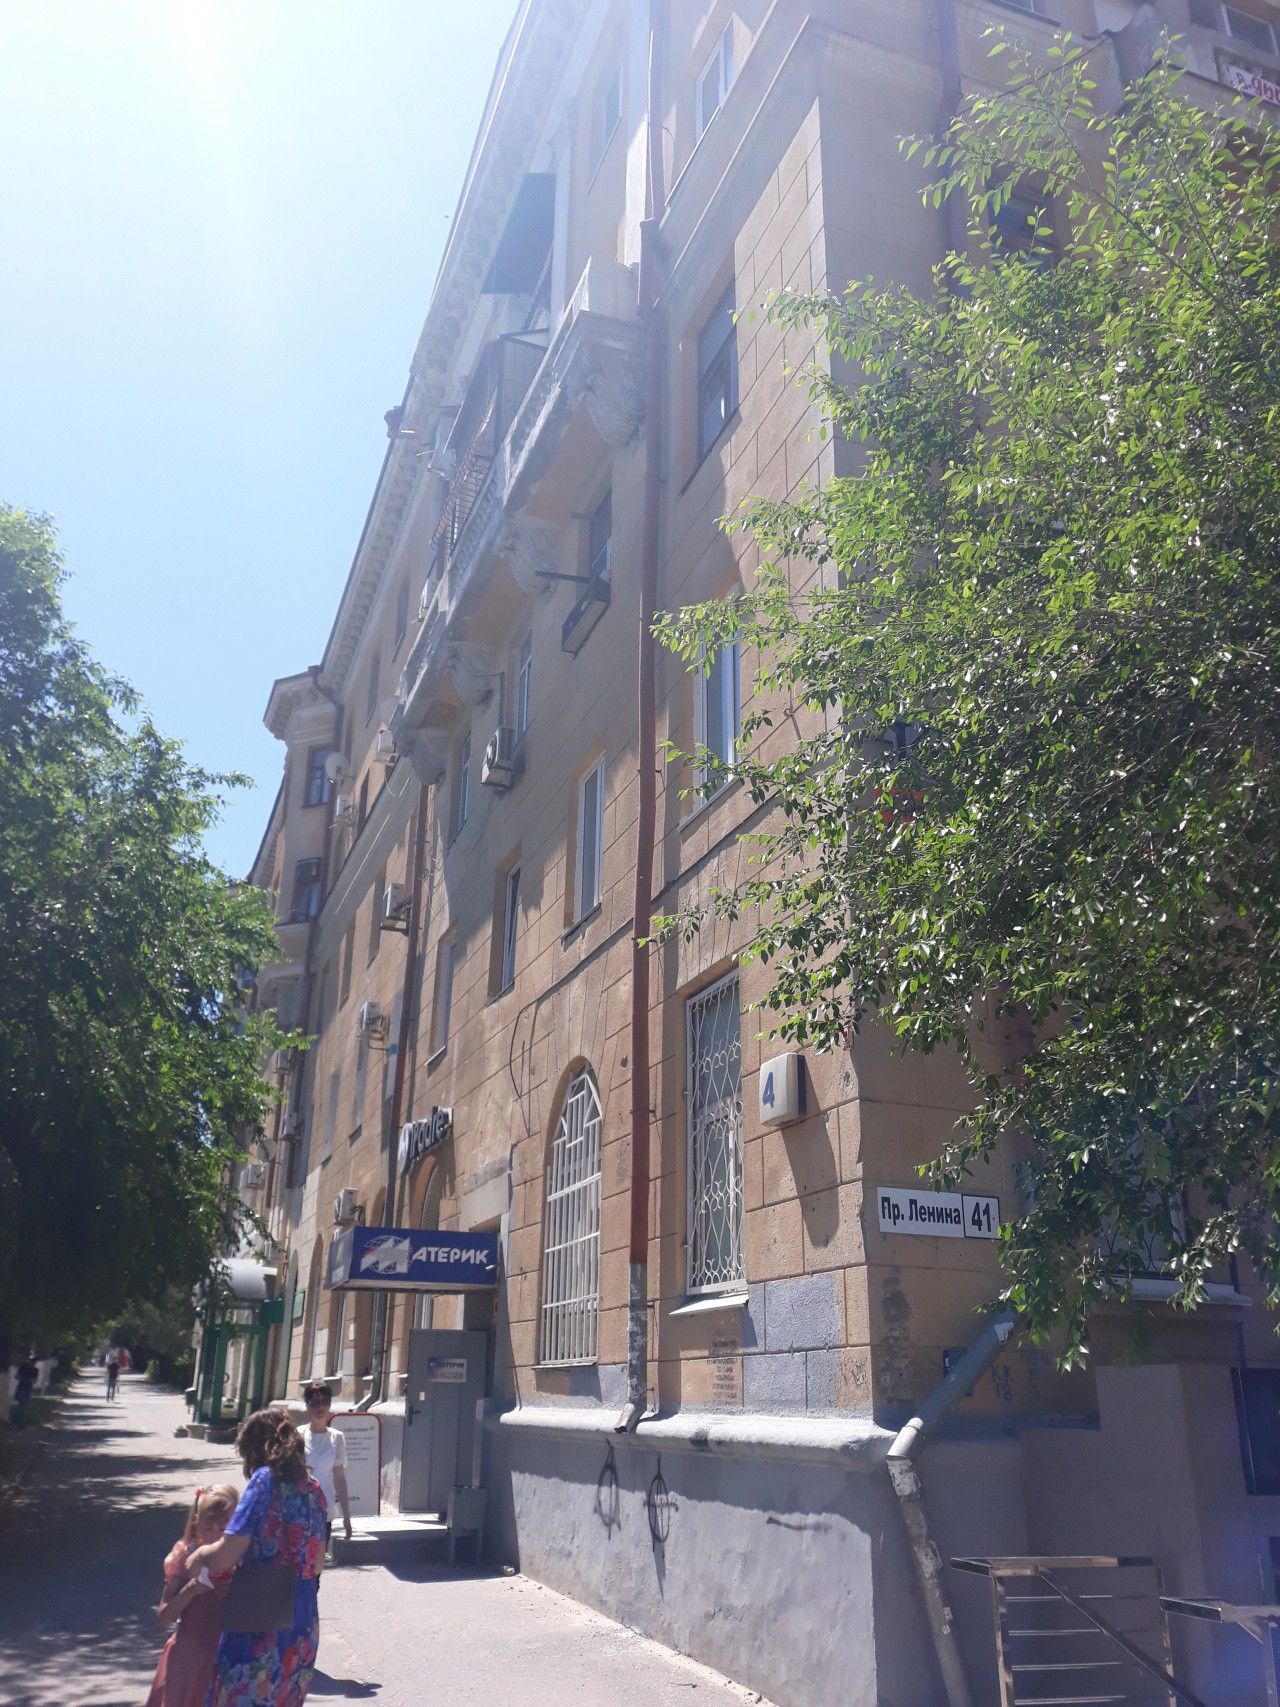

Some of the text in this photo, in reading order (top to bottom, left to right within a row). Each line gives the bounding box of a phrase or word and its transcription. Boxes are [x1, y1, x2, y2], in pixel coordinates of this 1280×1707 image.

[881, 1197, 992, 1232] Пр. Ленина 41
